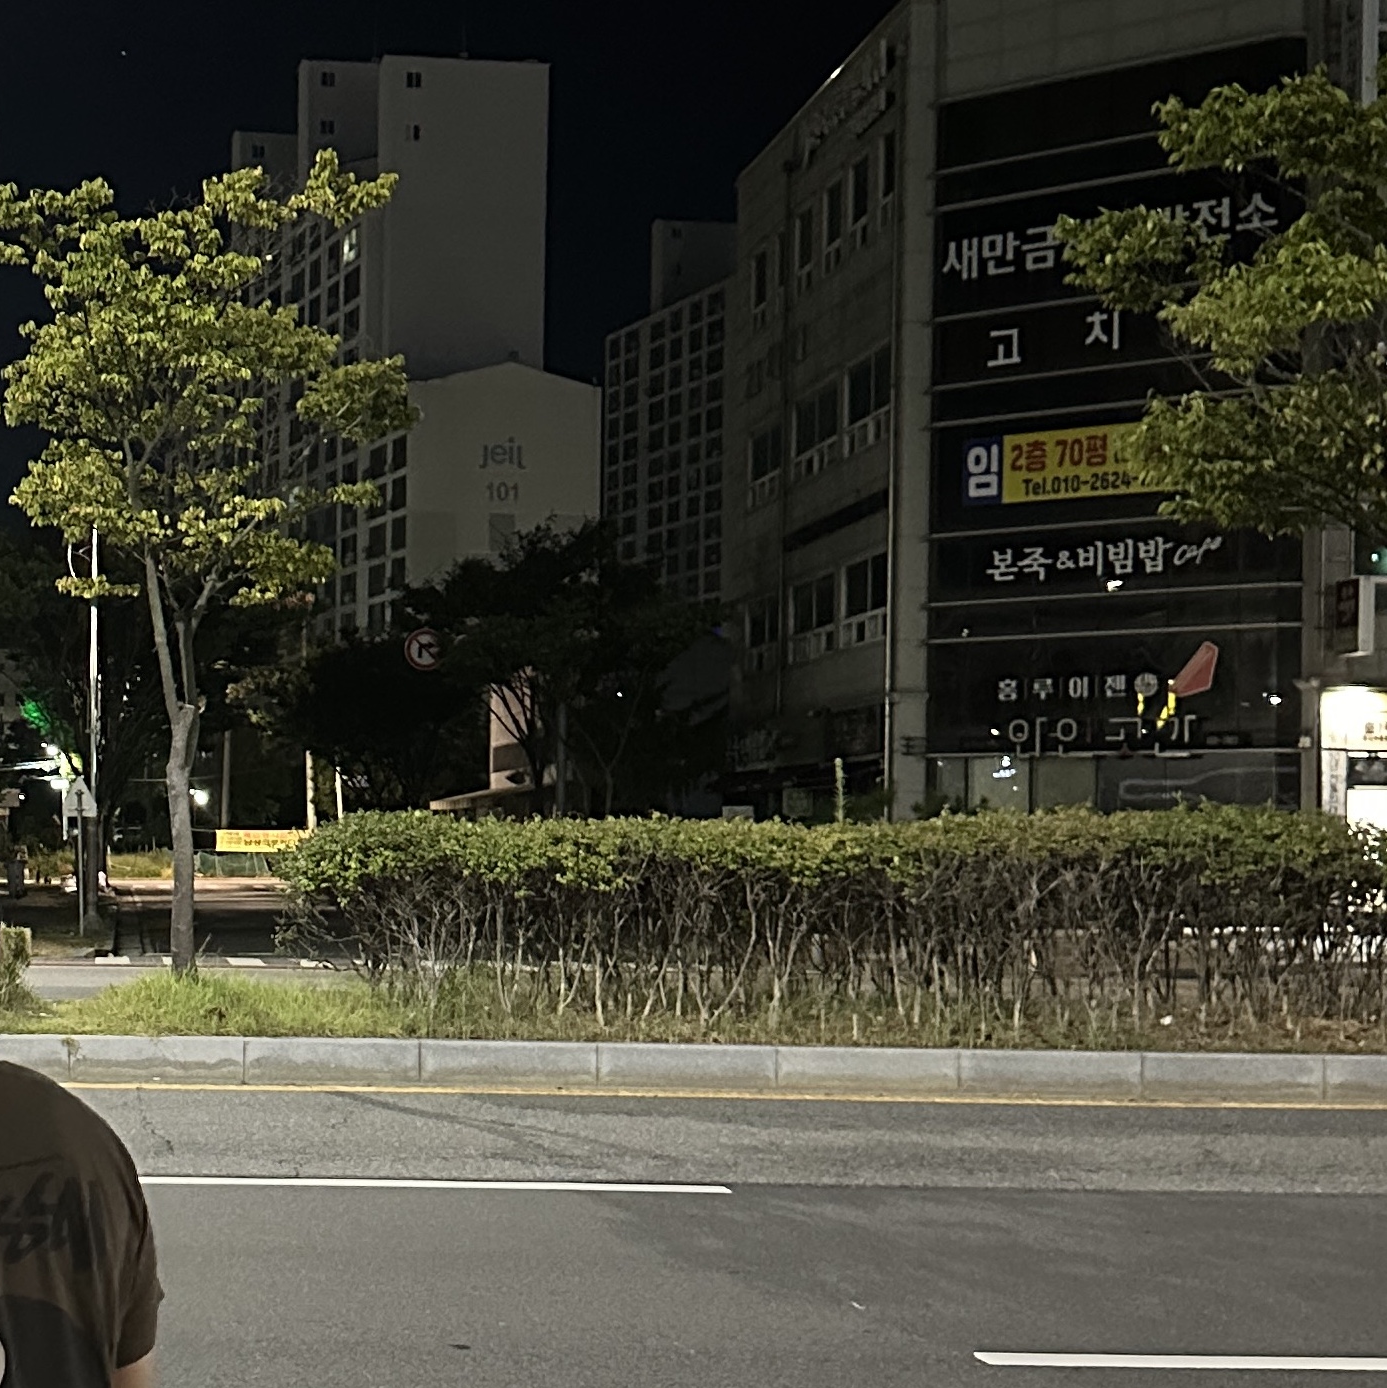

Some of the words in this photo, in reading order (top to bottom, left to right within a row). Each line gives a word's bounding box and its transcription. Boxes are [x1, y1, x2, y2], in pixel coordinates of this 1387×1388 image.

[966, 443, 1000, 499] 임
[1011, 439, 1048, 473] 2층
[1054, 432, 1108, 468] 70평
[486, 481, 519, 503] 101
[985, 535, 1175, 583] 본죽&비빔밥
